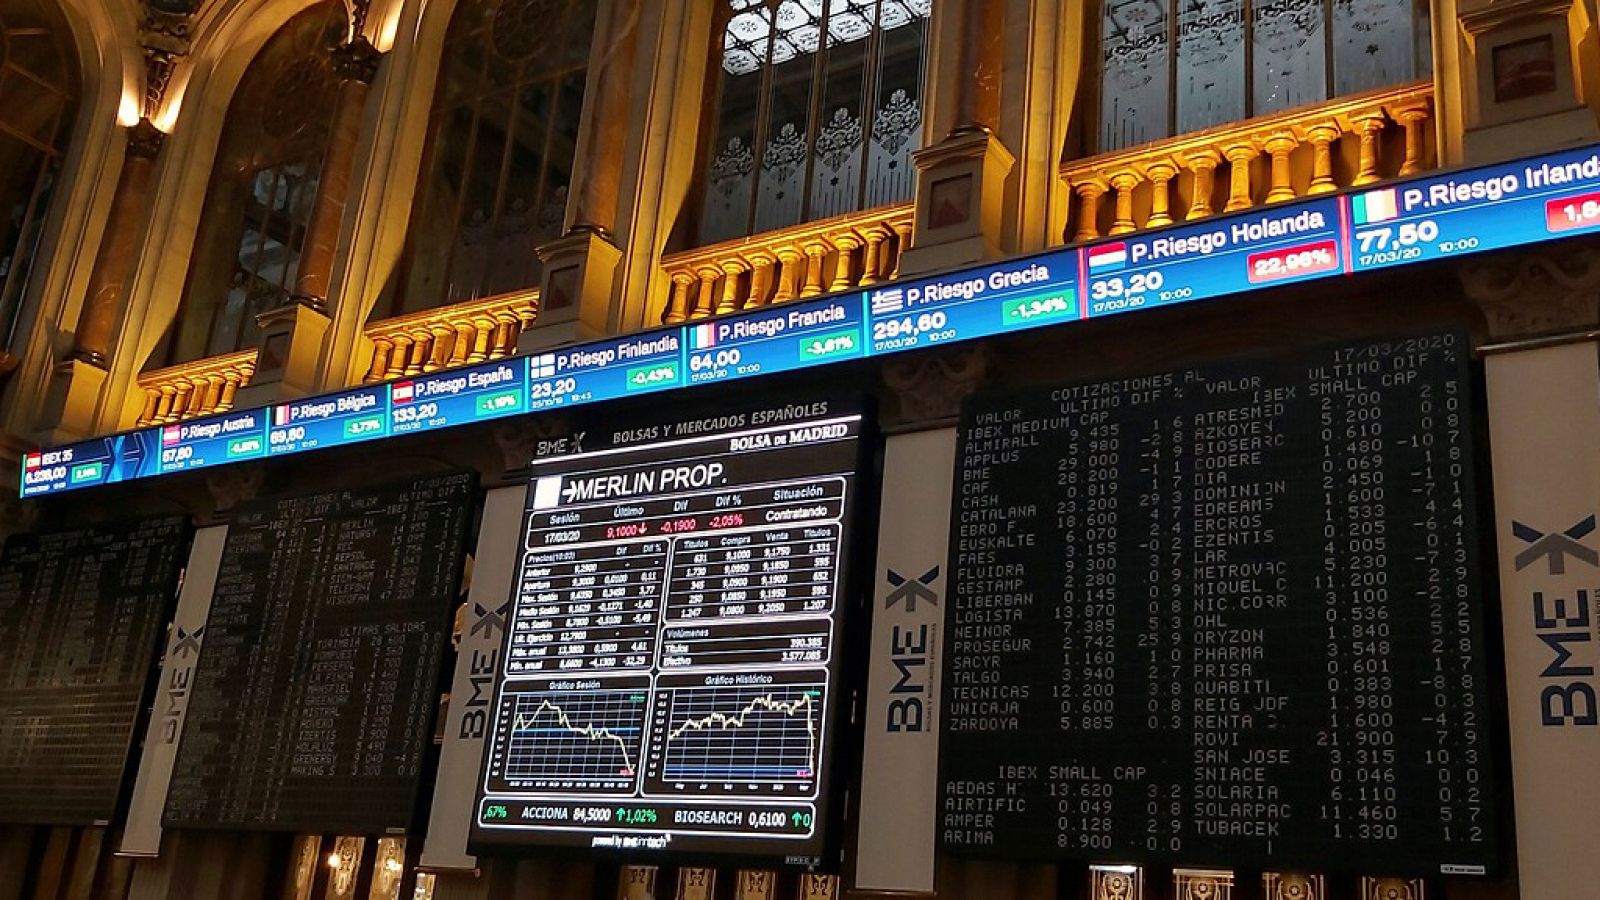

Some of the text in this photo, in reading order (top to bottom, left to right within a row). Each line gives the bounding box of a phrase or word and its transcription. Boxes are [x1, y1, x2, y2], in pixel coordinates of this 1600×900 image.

[1404, 155, 1600, 211] P.Riesgo Irland
[1132, 210, 1325, 263] P.Riesgo Holanda
[1357, 221, 1438, 252] 77,50
[1359, 237, 1478, 266] 17/03/20 10:00
[907, 264, 1050, 306] P.Riesgo Grecia
[1091, 271, 1163, 299] 33,20
[1159, 286, 1192, 301] 10:00
[719, 304, 846, 341] P.Riesgo Francia
[873, 311, 946, 340] 294,60
[928, 329, 956, 342] 10:00
[557, 336, 679, 371] P.Riesgo Finlandia
[1334, 334, 1454, 362] 17/03/2020
[690, 349, 741, 372] 64,00
[1205, 349, 1456, 395] VALOR ULTIMO DIF %
[415, 366, 513, 397] P.Riesgo España
[531, 378, 576, 398] 23,20
[1051, 370, 1205, 402] COTIZACIONES AL
[1308, 378, 1368, 397] SMALL
[1381, 371, 1418, 386] CAP
[291, 394, 375, 420] P.Riesgo Bélgica
[392, 403, 438, 423] 133,20
[976, 387, 1184, 425] VALOR ULTIMO DIF %
[1194, 403, 1284, 426] ATRESMED
[181, 415, 255, 440] P.Riesgo Austria
[612, 401, 828, 445] BOLSAS Y MERCADOS ESPAÑOLES
[967, 411, 1109, 440] IBEX MEDIUM CAP
[536, 438, 568, 456] BME
[729, 434, 772, 452] BOLSA
[788, 424, 848, 443] MADRID
[965, 435, 1039, 455] ALMIRALL
[963, 450, 1021, 467] APPLUS
[1194, 452, 1262, 471] CODERE
[575, 463, 727, 501] MERLIN PROP.
[963, 466, 992, 481] BME
[1194, 471, 1228, 486] DIA
[962, 481, 992, 495] CAF
[1194, 480, 1286, 502] DOMINION
[549, 486, 824, 525] Sesión Último Dif Dif % Situación
[961, 494, 1000, 509] CASH
[1194, 497, 1274, 517] EDREAMS
[765, 505, 828, 522] Contratando
[960, 504, 1037, 523] CATALANA
[960, 523, 998, 538] EBRO
[1194, 514, 1263, 533] ERCROS
[959, 533, 1036, 551] EUSKALTE
[1194, 529, 1275, 548] EZENTIS
[958, 551, 996, 566] FAES
[1194, 550, 1228, 564] LAR
[957, 563, 1025, 581] FLUIDRA
[1194, 561, 1288, 580] METROVAC
[957, 578, 1024, 595] GESTAMP
[1194, 577, 1288, 596] MIQUEL C
[955, 592, 1034, 609] LIBERBAN
[955, 608, 1023, 625] LOGISTA
[1194, 613, 1228, 628] OHL
[954, 624, 1012, 639] NEINOR
[1194, 628, 1264, 645] ORYZON
[954, 638, 1032, 654] PROSEGUR
[1194, 646, 1264, 661] PHARMA
[953, 655, 1001, 670] SACYR
[1533, 589, 1598, 726] BME
[887, 623, 927, 732] BME
[952, 670, 1001, 685] TALGO
[1194, 663, 1252, 678] PRISA
[459, 649, 497, 740] BME
[952, 685, 1031, 700] TECNICAS
[950, 701, 1020, 716] UNICAJA
[1194, 697, 1240, 712] REIG
[949, 717, 1019, 732] ZARDOYA
[1194, 714, 1254, 729] RENTA
[1194, 731, 1239, 747] ROVI
[1193, 749, 1229, 764] SAN
[1240, 749, 1291, 764] JOSE
[999, 766, 1147, 781] IBEX SMALL CAP
[1193, 767, 1266, 781] SNIACE
[946, 782, 996, 796] AEDAS
[1193, 785, 1280, 800] SOLARIA
[945, 797, 1027, 812] AIRTIFIC
[1193, 802, 1292, 818] SOLARPAC
[521, 805, 787, 829] ACCIONA 84,5000 1,02% BIOSEARCH 0,6100
[944, 813, 995, 828] AMPER
[943, 830, 994, 845] ARIMA
